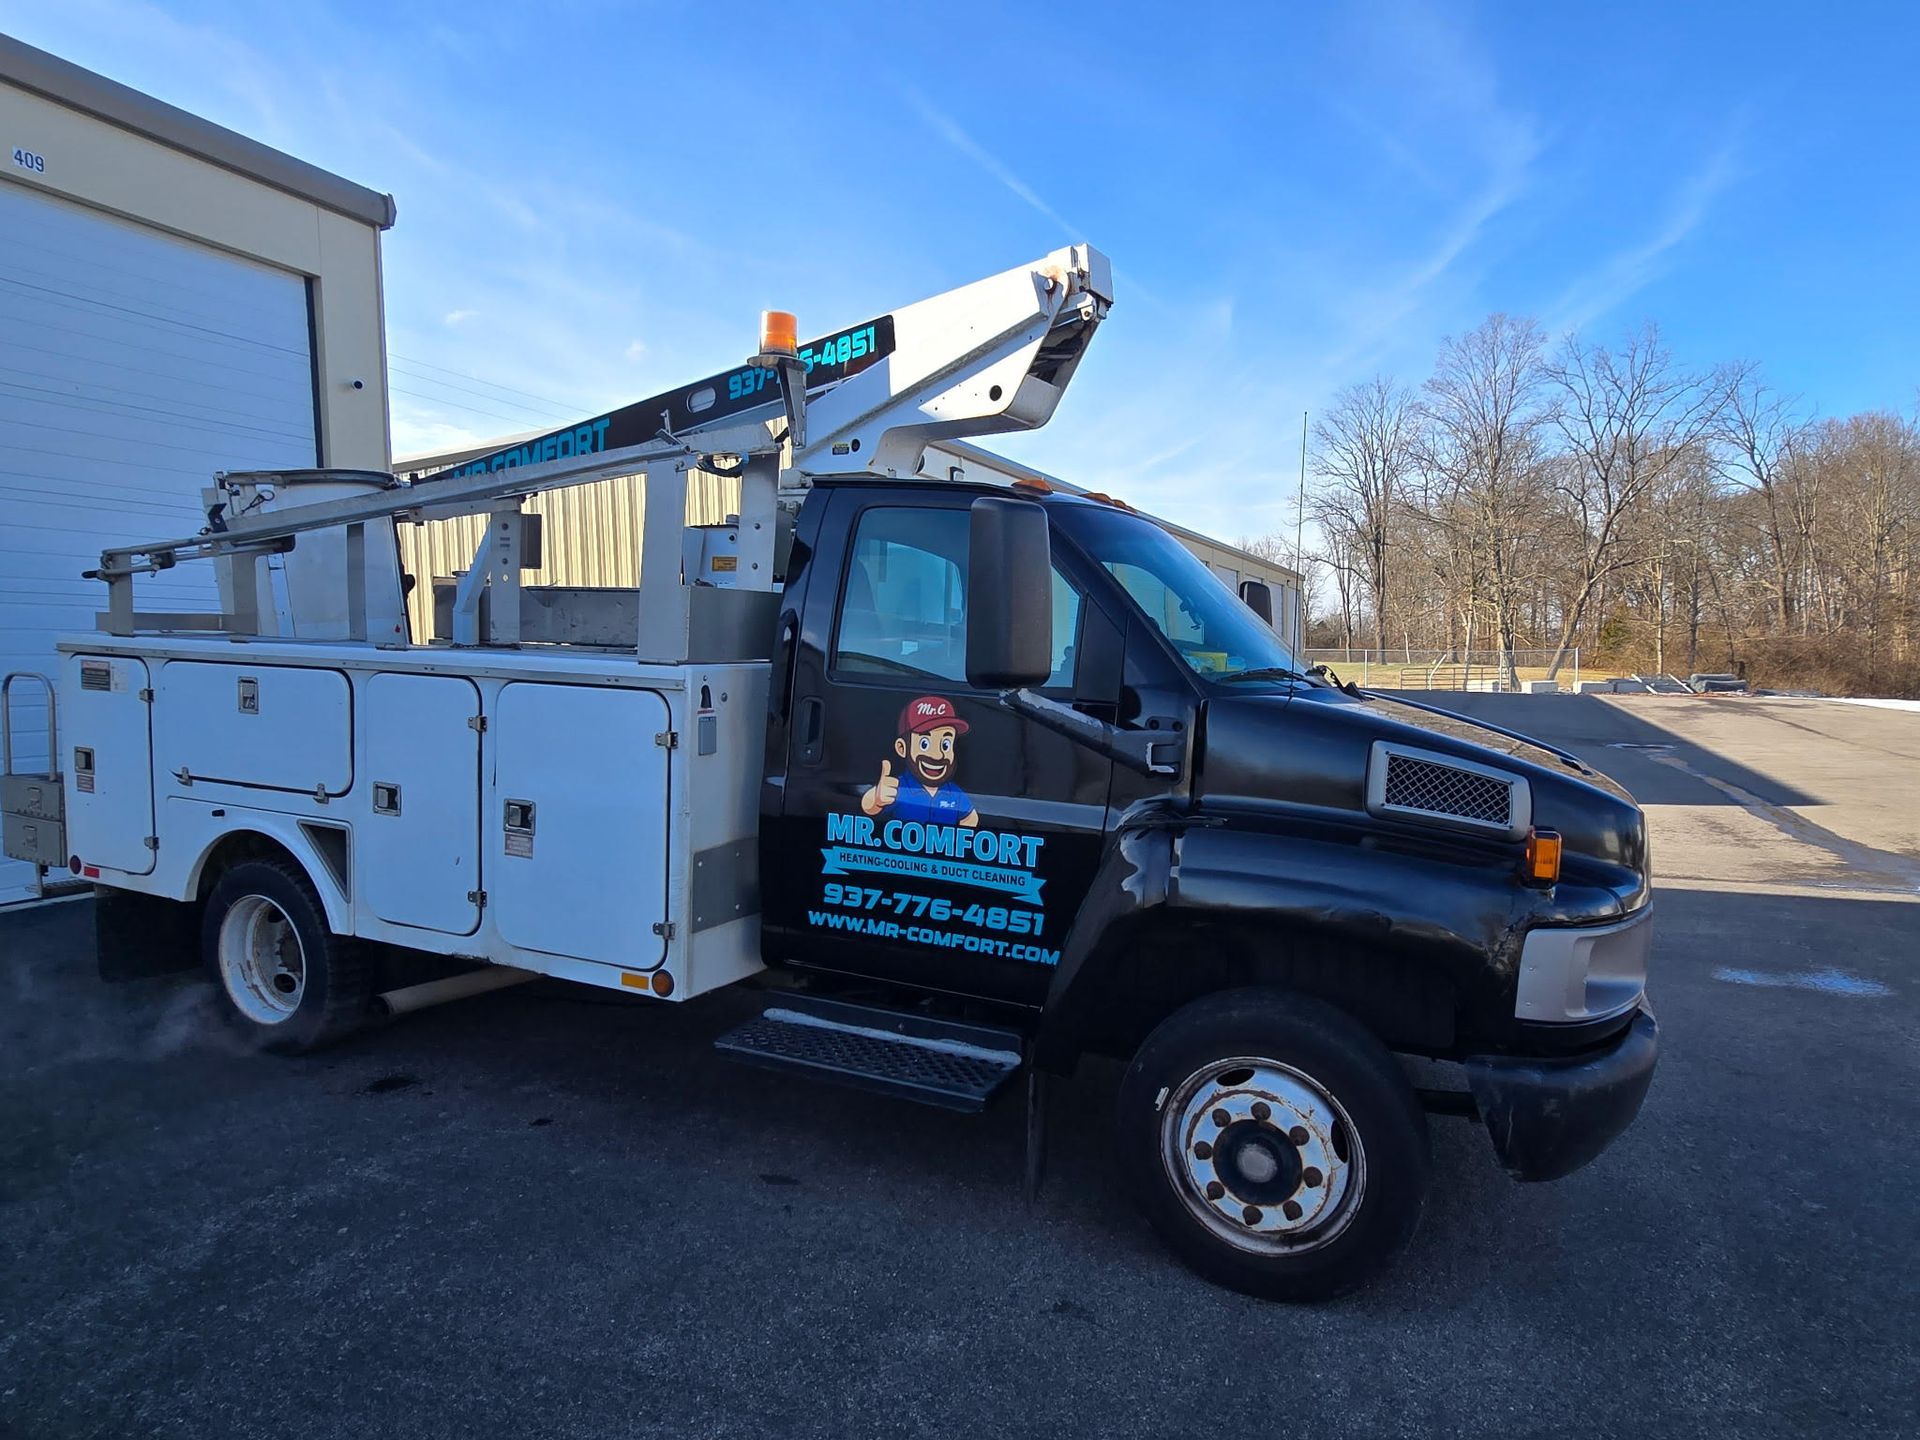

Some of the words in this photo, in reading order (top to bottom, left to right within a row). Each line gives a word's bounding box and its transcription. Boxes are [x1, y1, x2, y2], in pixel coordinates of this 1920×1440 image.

[14, 150, 44, 172] 409
[728, 326, 875, 400] 937-6-4851
[917, 703, 946, 715] Mr.C
[930, 864, 938, 875] &
[941, 865, 969, 879] DUCT
[972, 869, 1026, 887] CLEANING
[823, 882, 1045, 936] 937-776-4851
[808, 910, 1060, 966] WWW.MR-COMFORT.COM
